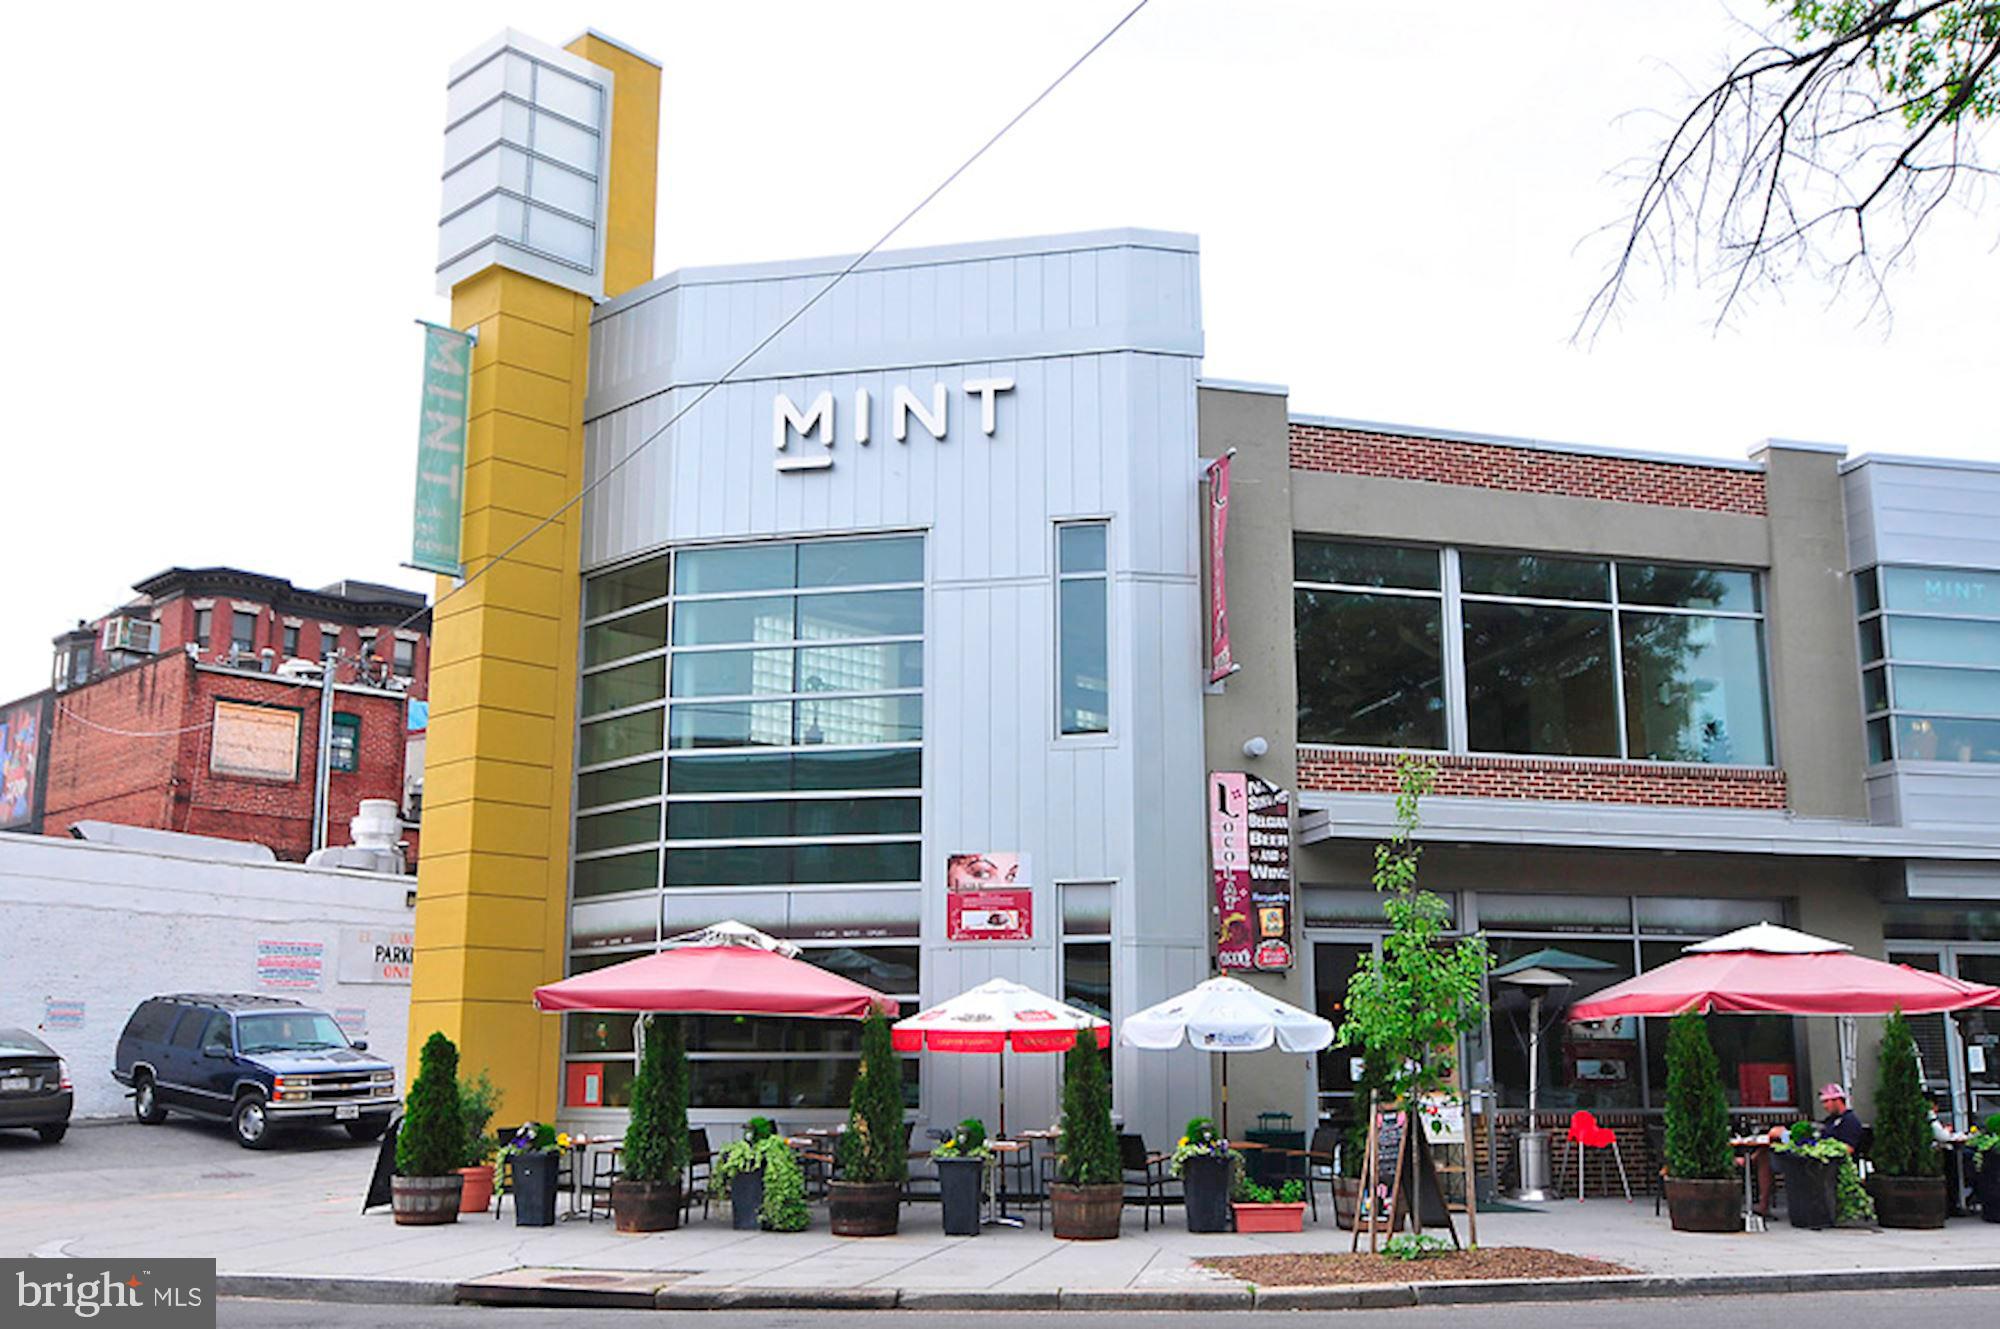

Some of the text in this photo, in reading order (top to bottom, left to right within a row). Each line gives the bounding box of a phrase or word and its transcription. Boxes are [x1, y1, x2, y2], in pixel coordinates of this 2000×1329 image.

[422, 327, 467, 500] MINT
[774, 378, 1016, 452] MINT
[1925, 579, 1985, 600] MINT
